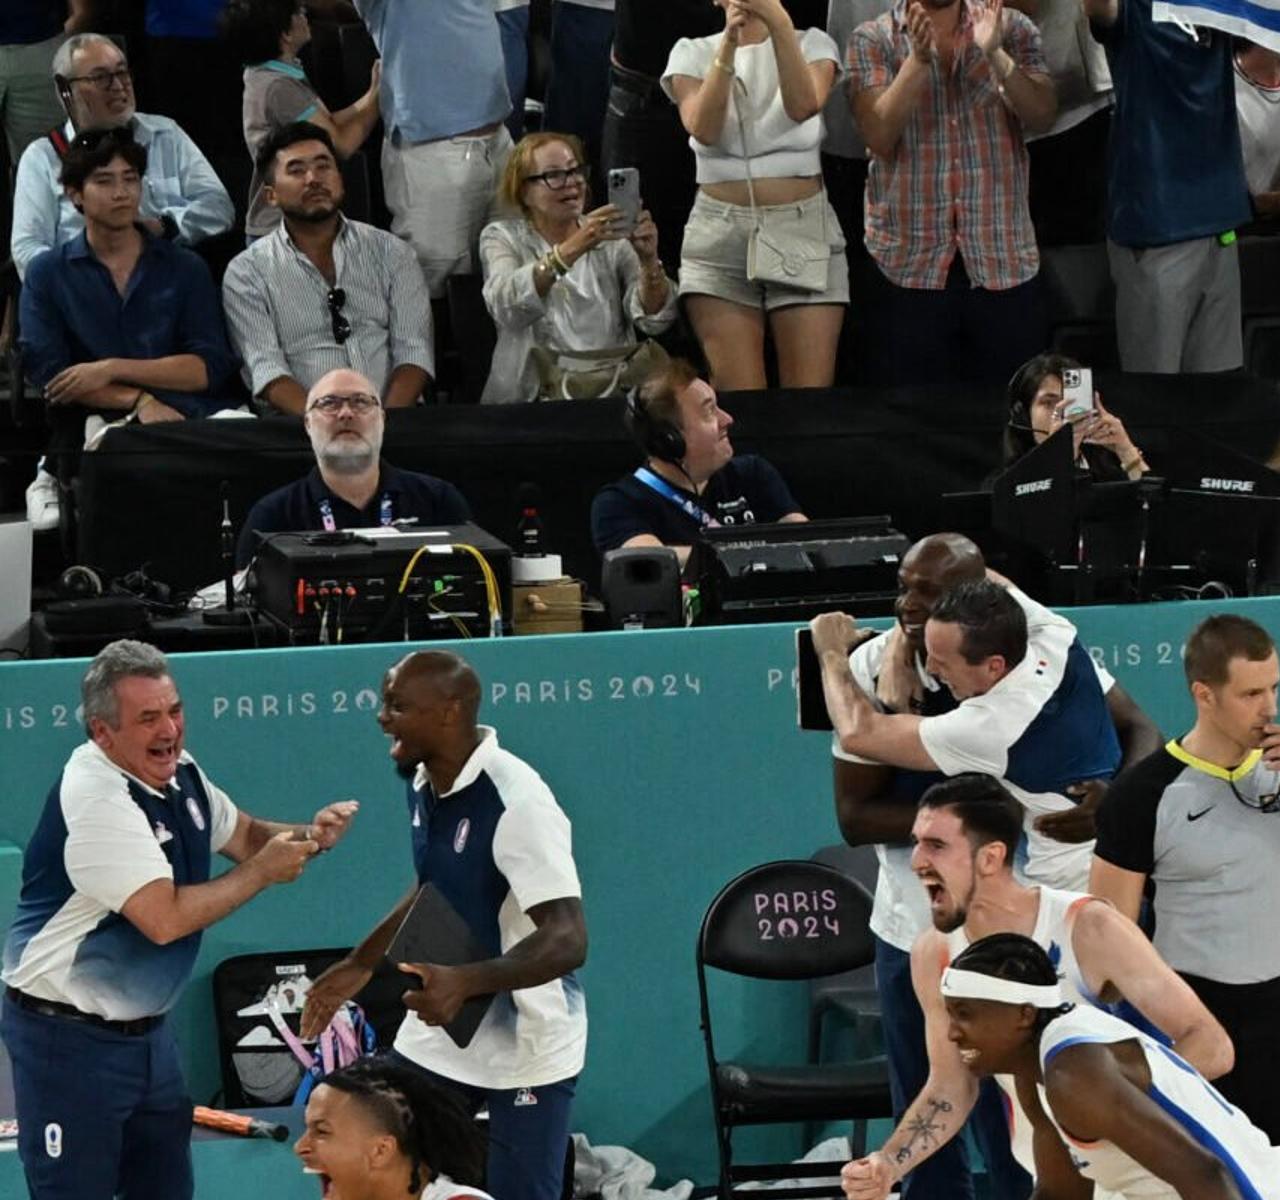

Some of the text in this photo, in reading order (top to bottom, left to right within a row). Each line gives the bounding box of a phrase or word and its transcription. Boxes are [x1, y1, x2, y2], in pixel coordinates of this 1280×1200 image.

[1015, 478, 1053, 496] SHURE
[1200, 478, 1254, 492] SHURE
[608, 673, 700, 699] 2024
[758, 915, 839, 940] 2024
